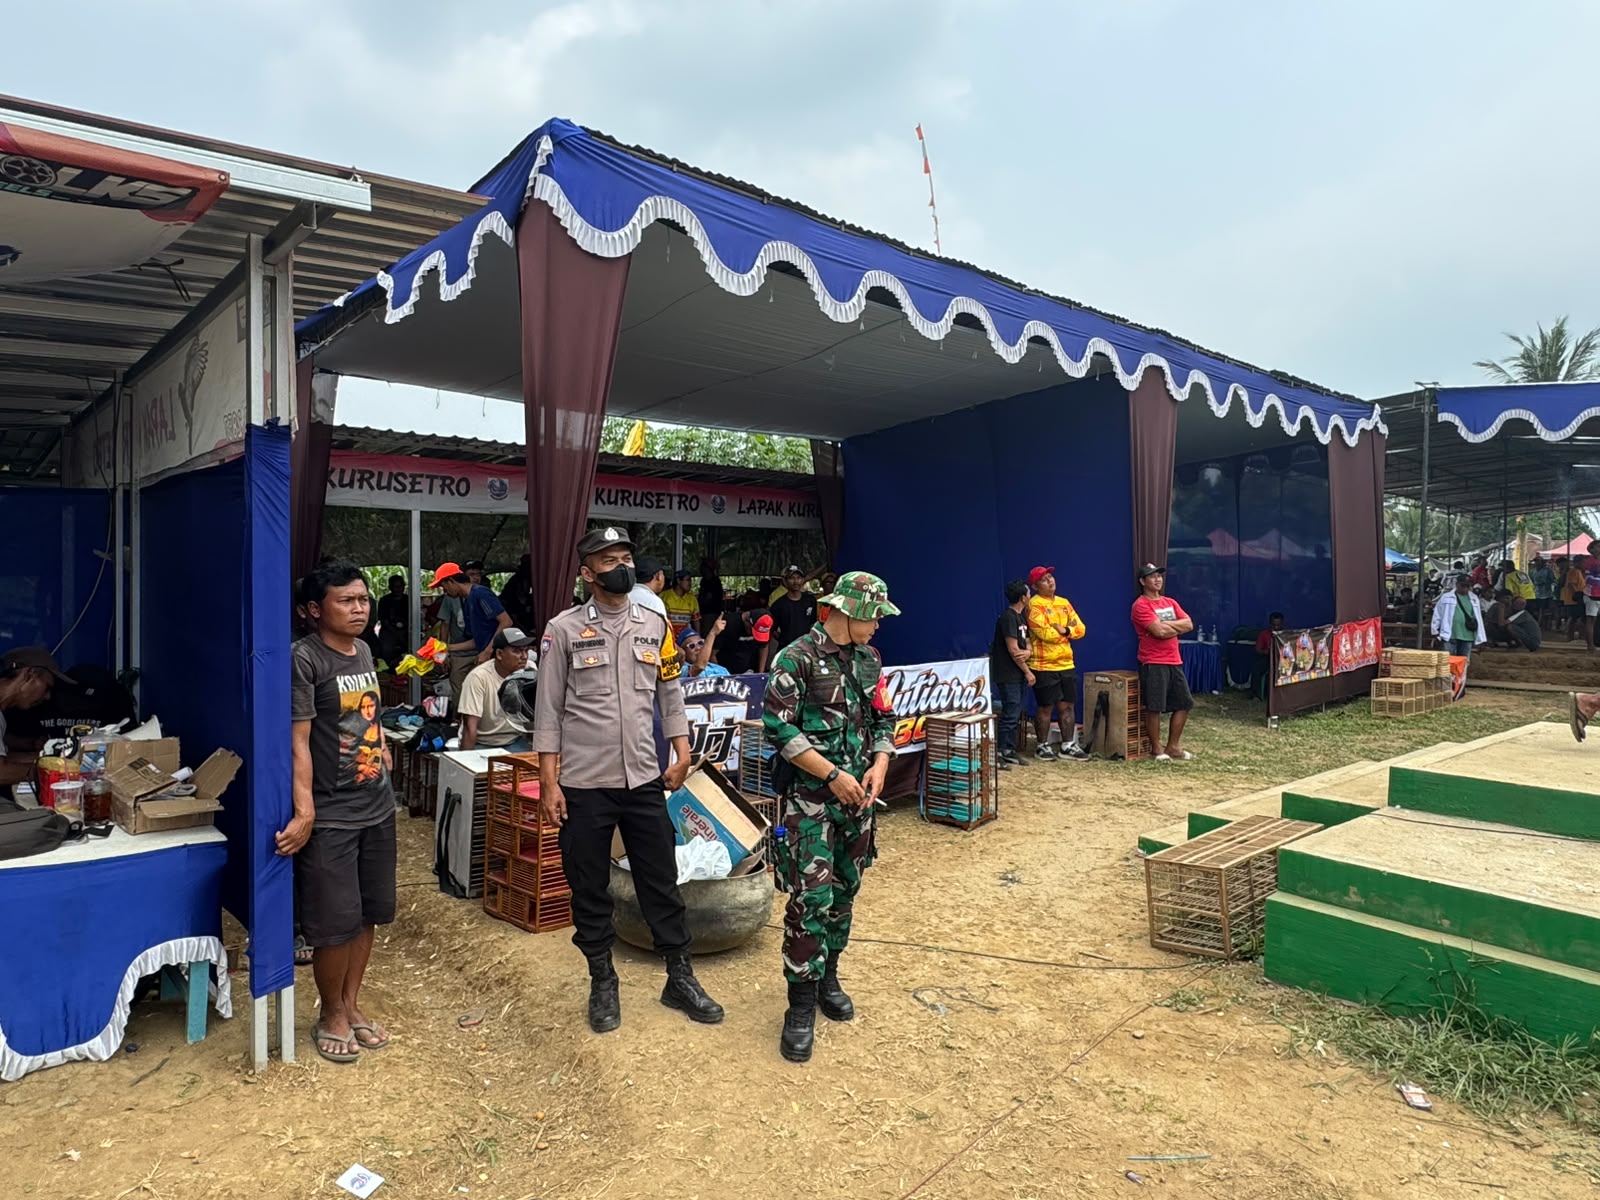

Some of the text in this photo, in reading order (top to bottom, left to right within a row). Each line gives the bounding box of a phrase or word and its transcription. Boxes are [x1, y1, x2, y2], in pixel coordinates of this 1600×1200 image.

[327, 467, 472, 497] KURUSETRO
[594, 486, 700, 512] KURUSETRO
[737, 499, 784, 517] LAPAK
